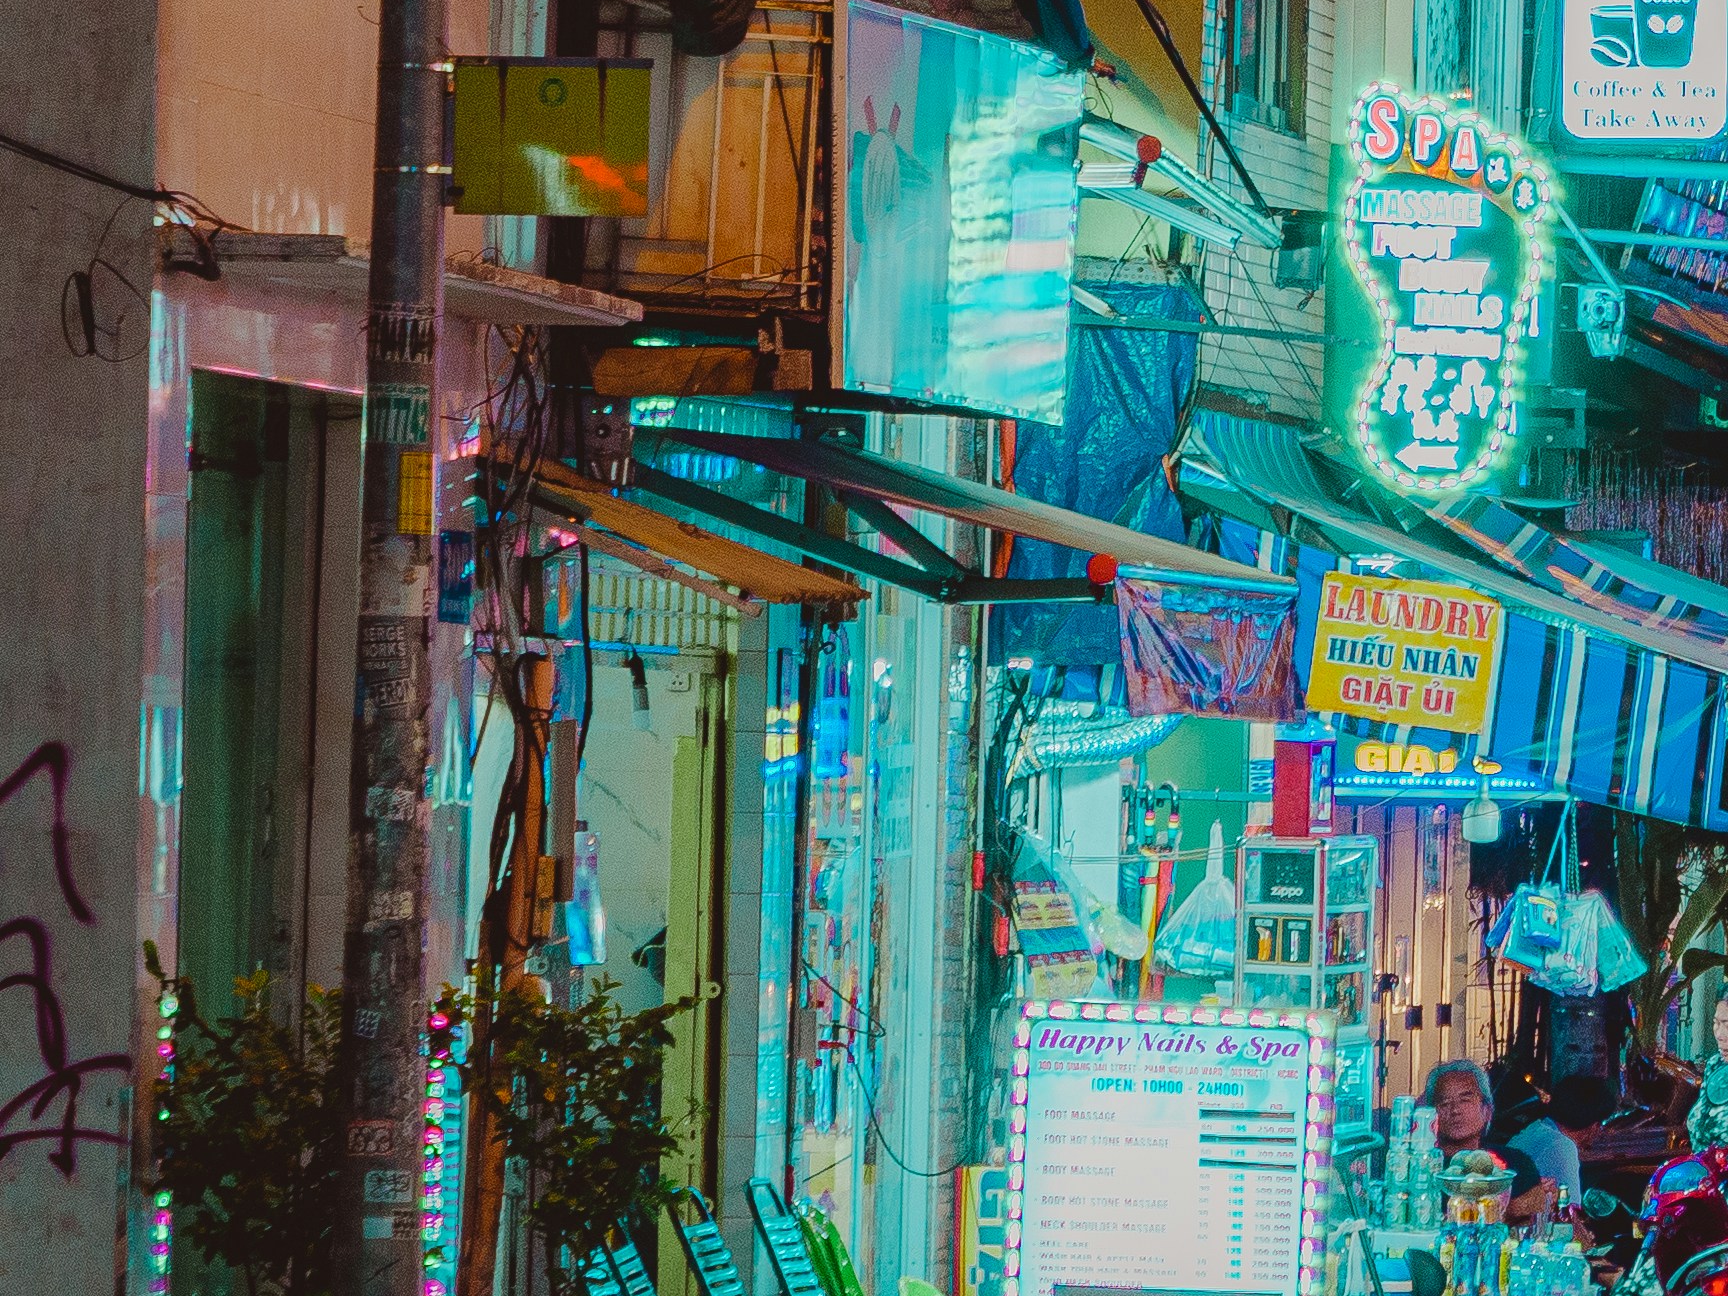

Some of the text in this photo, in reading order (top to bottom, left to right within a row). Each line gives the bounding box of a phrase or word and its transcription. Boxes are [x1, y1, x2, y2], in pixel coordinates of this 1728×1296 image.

[1574, 81, 1716, 98] Coffee & Tea
[1580, 109, 1709, 132] Take Away
[1365, 99, 1480, 171] SPA
[1361, 190, 1482, 226] MASSAGE
[1324, 585, 1495, 639] LAUNDRY
[1327, 635, 1479, 679] HIẾU NHÂN
[1341, 675, 1455, 714] GIẶT ỦI
[1270, 887, 1303, 898] zippo
[1039, 1028, 1301, 1061] Happy Nails & Spa
[1091, 1078, 1244, 1097] (OPEN: 10H00 24H00)
[1044, 1110, 1116, 1121] FOOT MASSAGE
[1044, 1134, 1067, 1144] FOOT
[1124, 1137, 1169, 1147] MASSAGE
[1042, 1165, 1115, 1176] BODY MASSAGE
[1124, 1198, 1169, 1209] MASSAGE
[1121, 1222, 1167, 1233] MASSAGE
